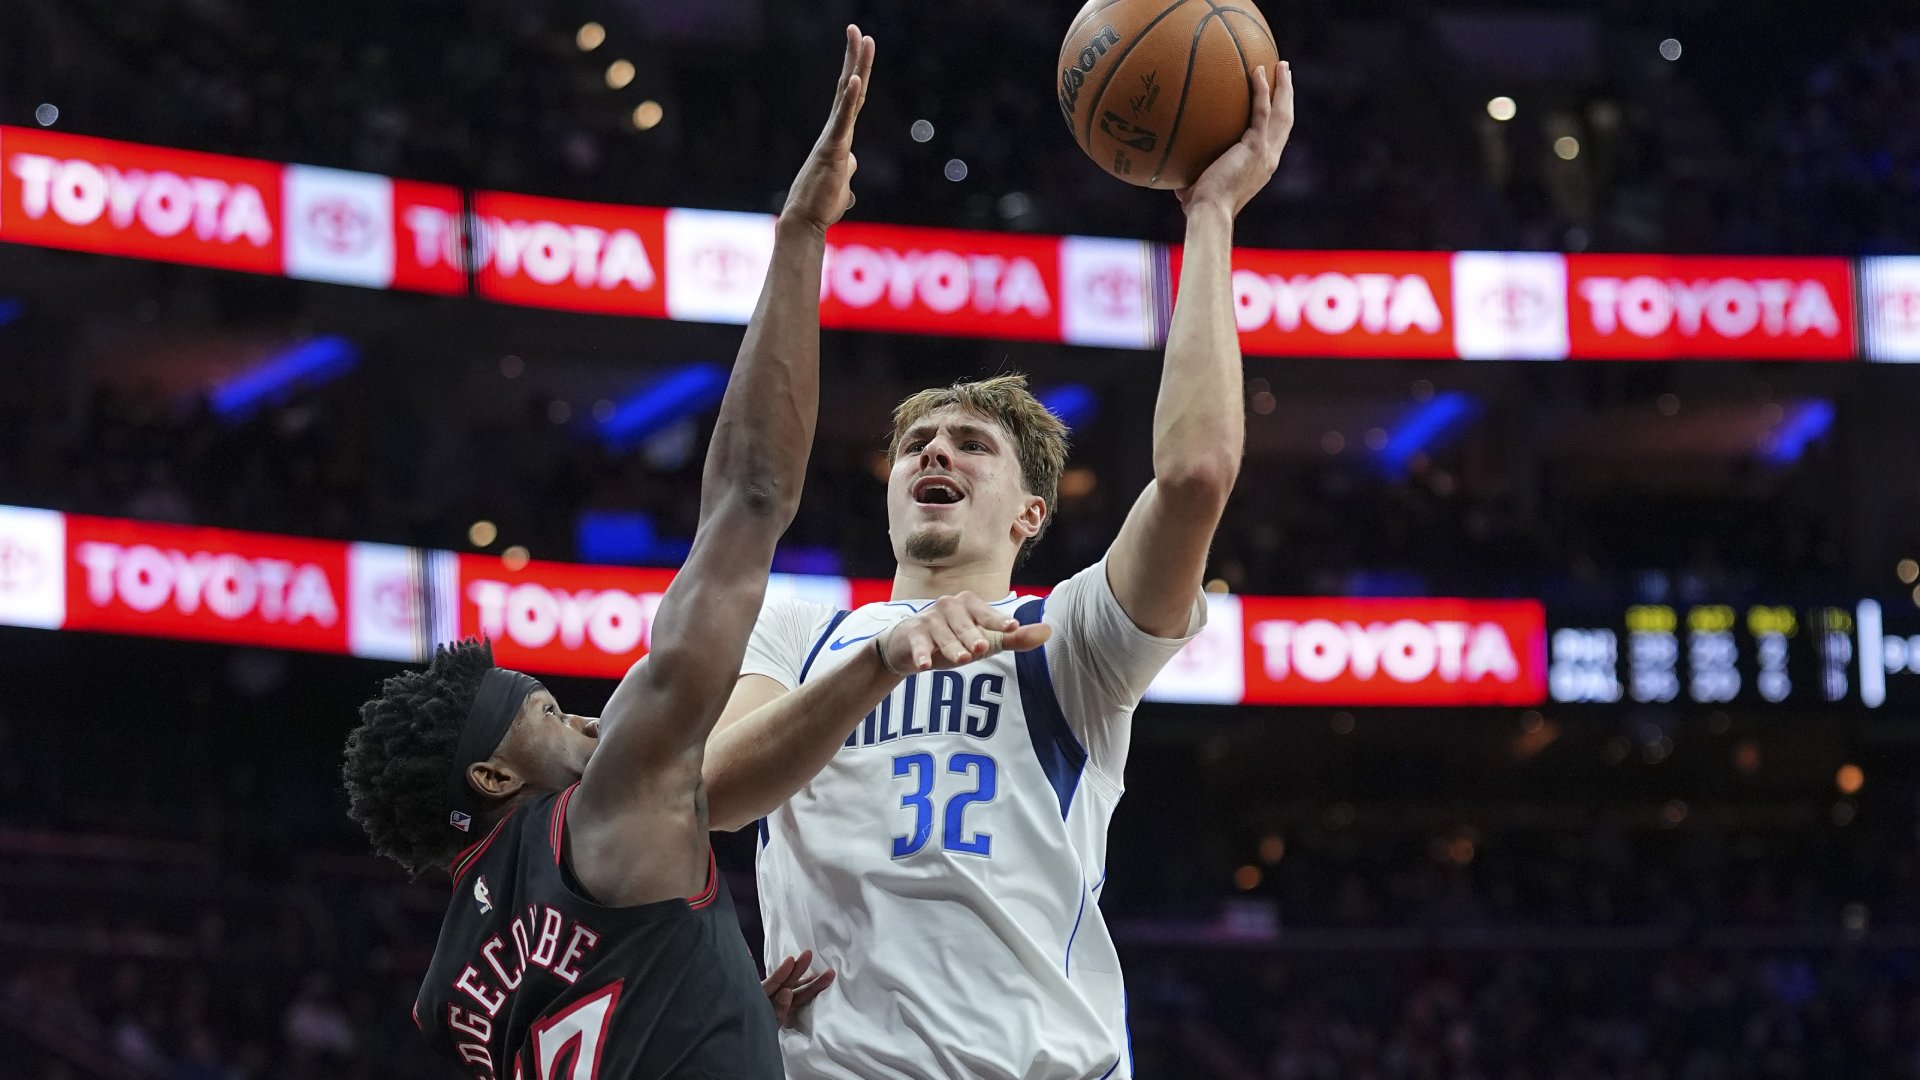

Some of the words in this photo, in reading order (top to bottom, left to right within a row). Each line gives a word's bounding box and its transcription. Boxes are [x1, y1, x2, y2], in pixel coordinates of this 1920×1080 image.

[10, 152, 272, 247] TOYOTA
[405, 204, 655, 290] TOYOTA
[1233, 270, 1442, 333] OYOTA
[1579, 276, 1840, 338] TOYOTA
[77, 540, 338, 627] TOYOTA
[1252, 619, 1521, 683] TOYOTA
[842, 670, 1006, 750] LLAS
[891, 751, 999, 860] 32
